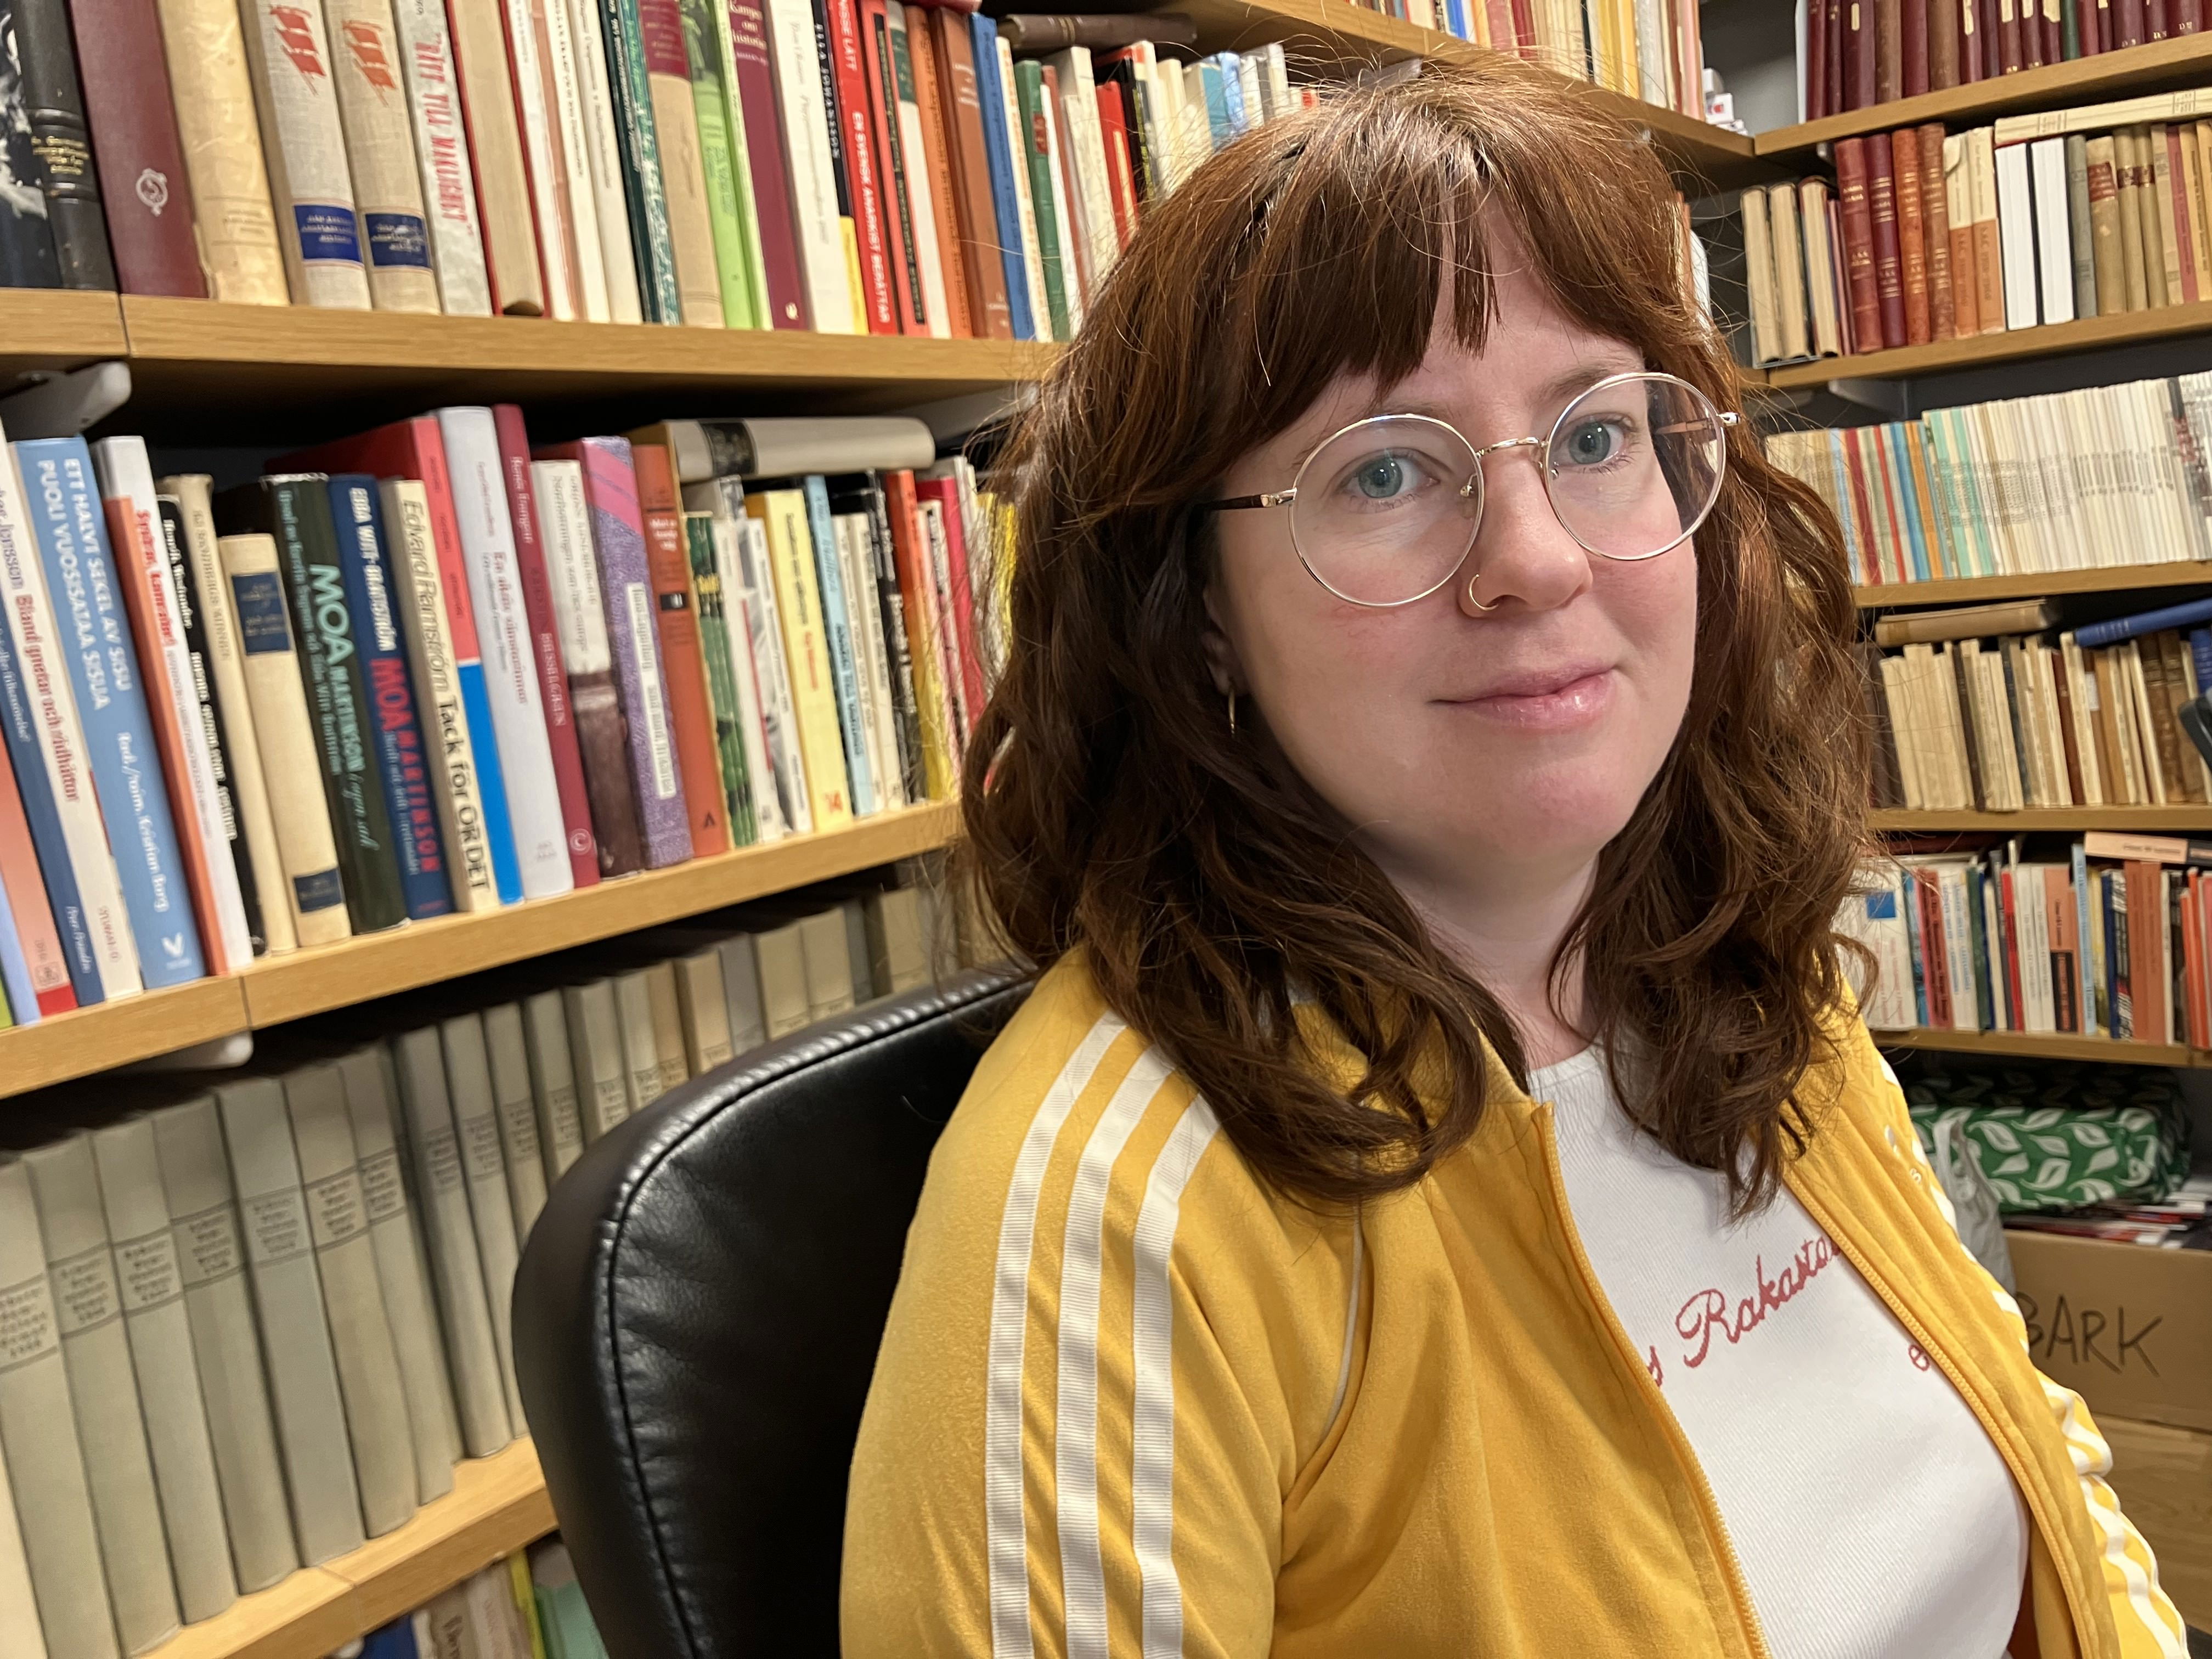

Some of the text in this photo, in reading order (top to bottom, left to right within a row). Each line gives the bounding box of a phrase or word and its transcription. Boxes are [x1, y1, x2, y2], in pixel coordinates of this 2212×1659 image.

[856, 133, 871, 184] SVENSK
[862, 186, 880, 252] ANARKIST
[872, 255, 891, 323] BERÄTTAR
[38, 460, 111, 709] PUOLI VUOSISATAA SISUA
[64, 458, 133, 692] ETT HALVT SEKEL AV SISU
[309, 563, 354, 667] MOA
[439, 696, 467, 754] Tack
[369, 658, 439, 872] MOA MARTINSON
[450, 761, 470, 799] för
[459, 805, 490, 892] ORDET
[151, 874, 171, 912] Borg
